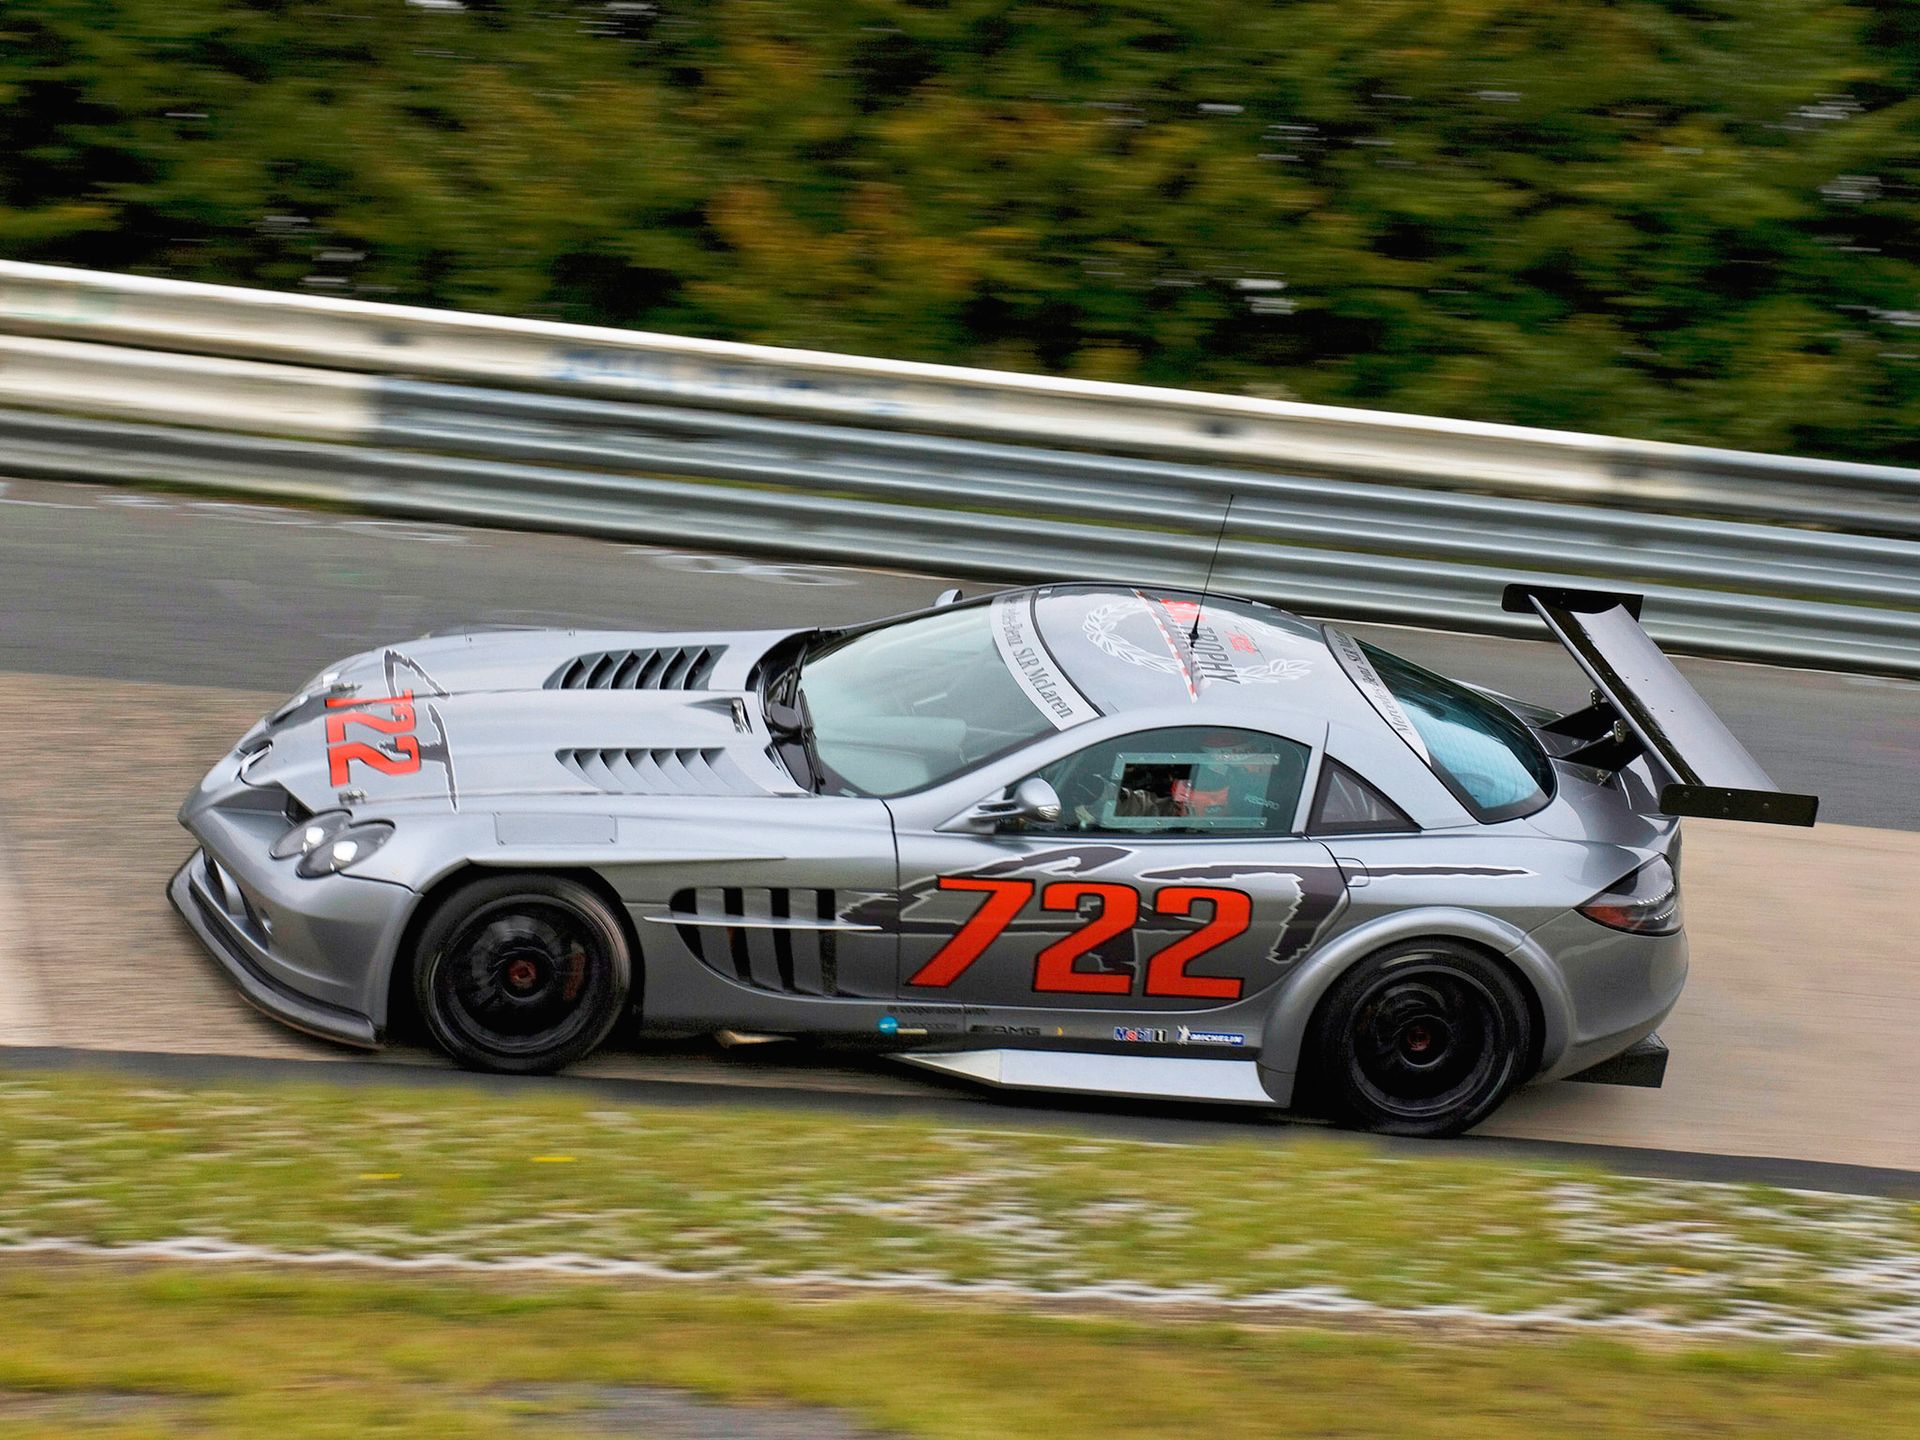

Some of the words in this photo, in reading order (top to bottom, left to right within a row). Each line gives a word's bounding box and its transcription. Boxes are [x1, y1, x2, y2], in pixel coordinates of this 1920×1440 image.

[1012, 646, 1041, 676] SLR
[1025, 666, 1074, 720] McLaren
[325, 688, 423, 788] 722
[904, 875, 1254, 1000] 722
[993, 1025, 1041, 1037] AMG
[1190, 1033, 1243, 1045] MICHELIN
